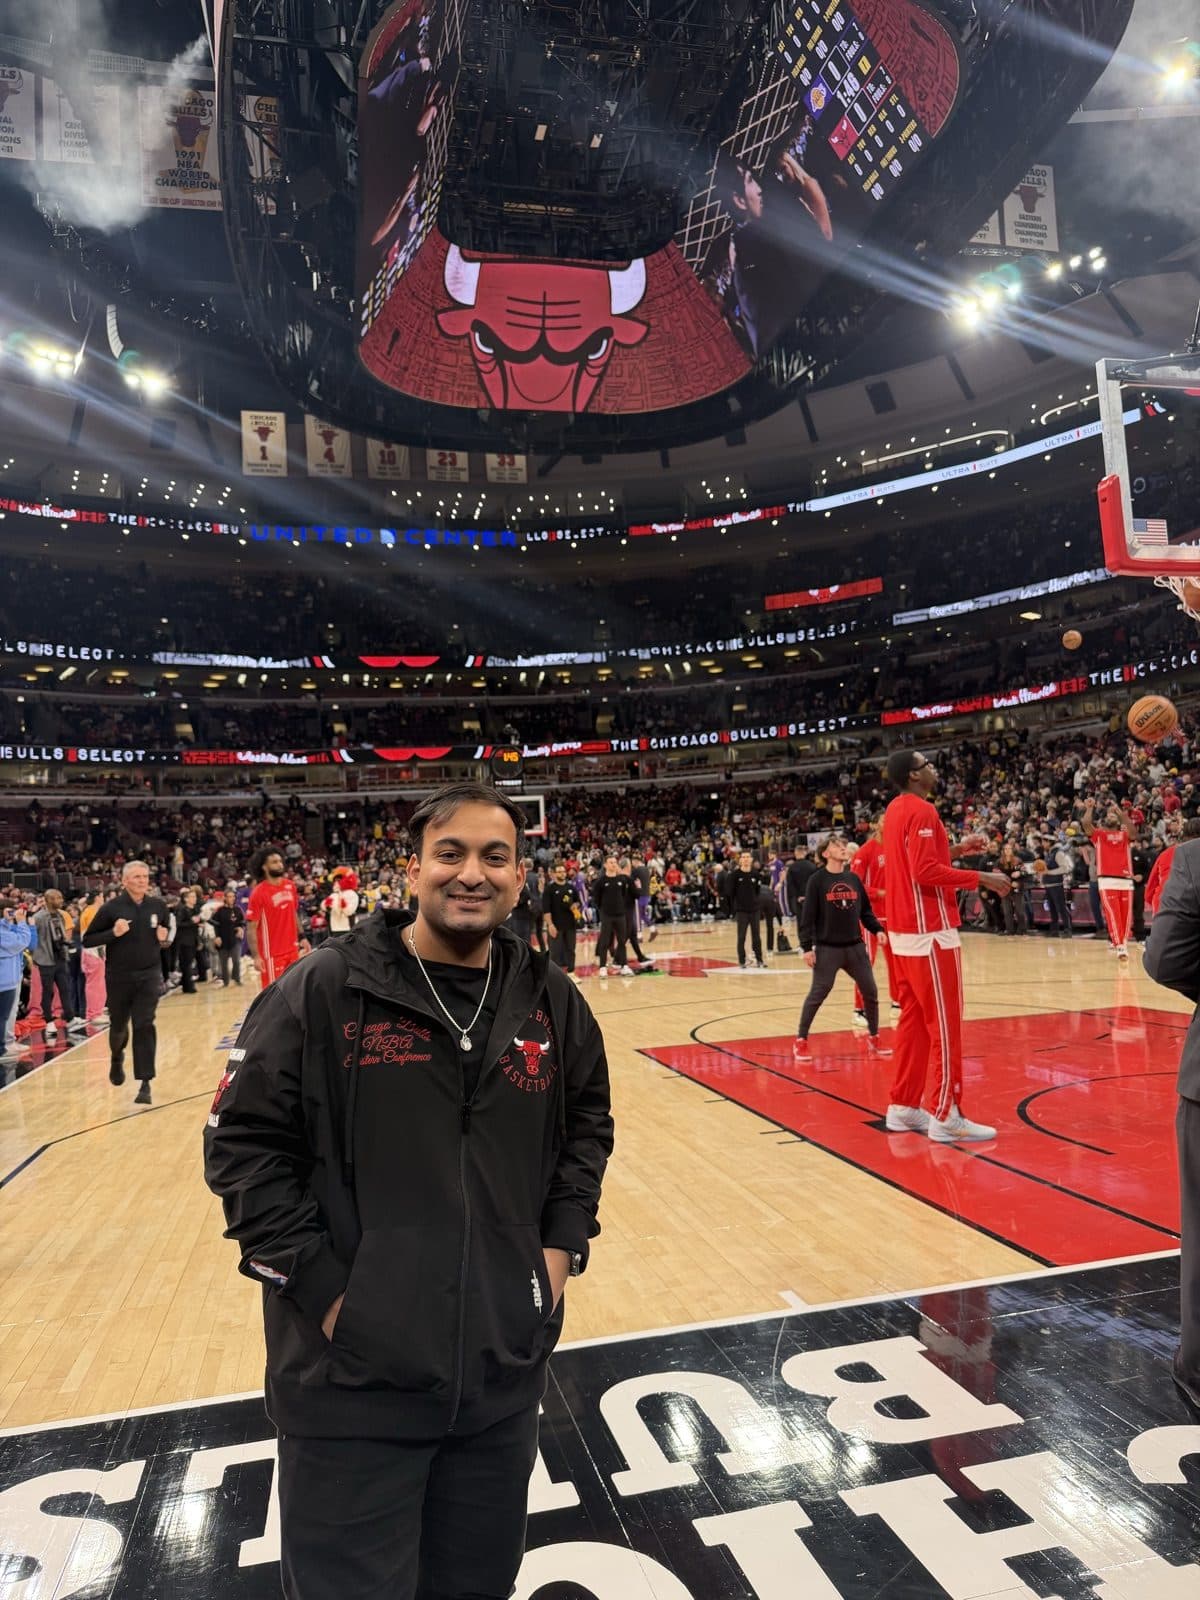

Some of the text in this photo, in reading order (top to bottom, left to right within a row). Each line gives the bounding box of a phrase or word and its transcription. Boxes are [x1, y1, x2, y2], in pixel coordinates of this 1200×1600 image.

[828, 60, 841, 81] 0
[853, 102, 867, 123] 0
[177, 159, 201, 169] NBA
[168, 169, 210, 180] WORLD
[155, 178, 220, 190] CHAMPION
[1044, 434, 1074, 448] ULTRA
[260, 446, 268, 461] 1
[323, 447, 336, 463] 4
[380, 449, 397, 465] 10
[437, 452, 457, 467] 23
[108, 512, 137, 526] THE
[251, 524, 518, 546] UNITED CENTER
[1089, 668, 1123, 685] THE
[611, 739, 639, 751] THE
[650, 731, 719, 749] CHICAGO
[344, 1021, 391, 1040] Cicago
[362, 1034, 414, 1051] NBA
[343, 1049, 432, 1068] Estern Conference
